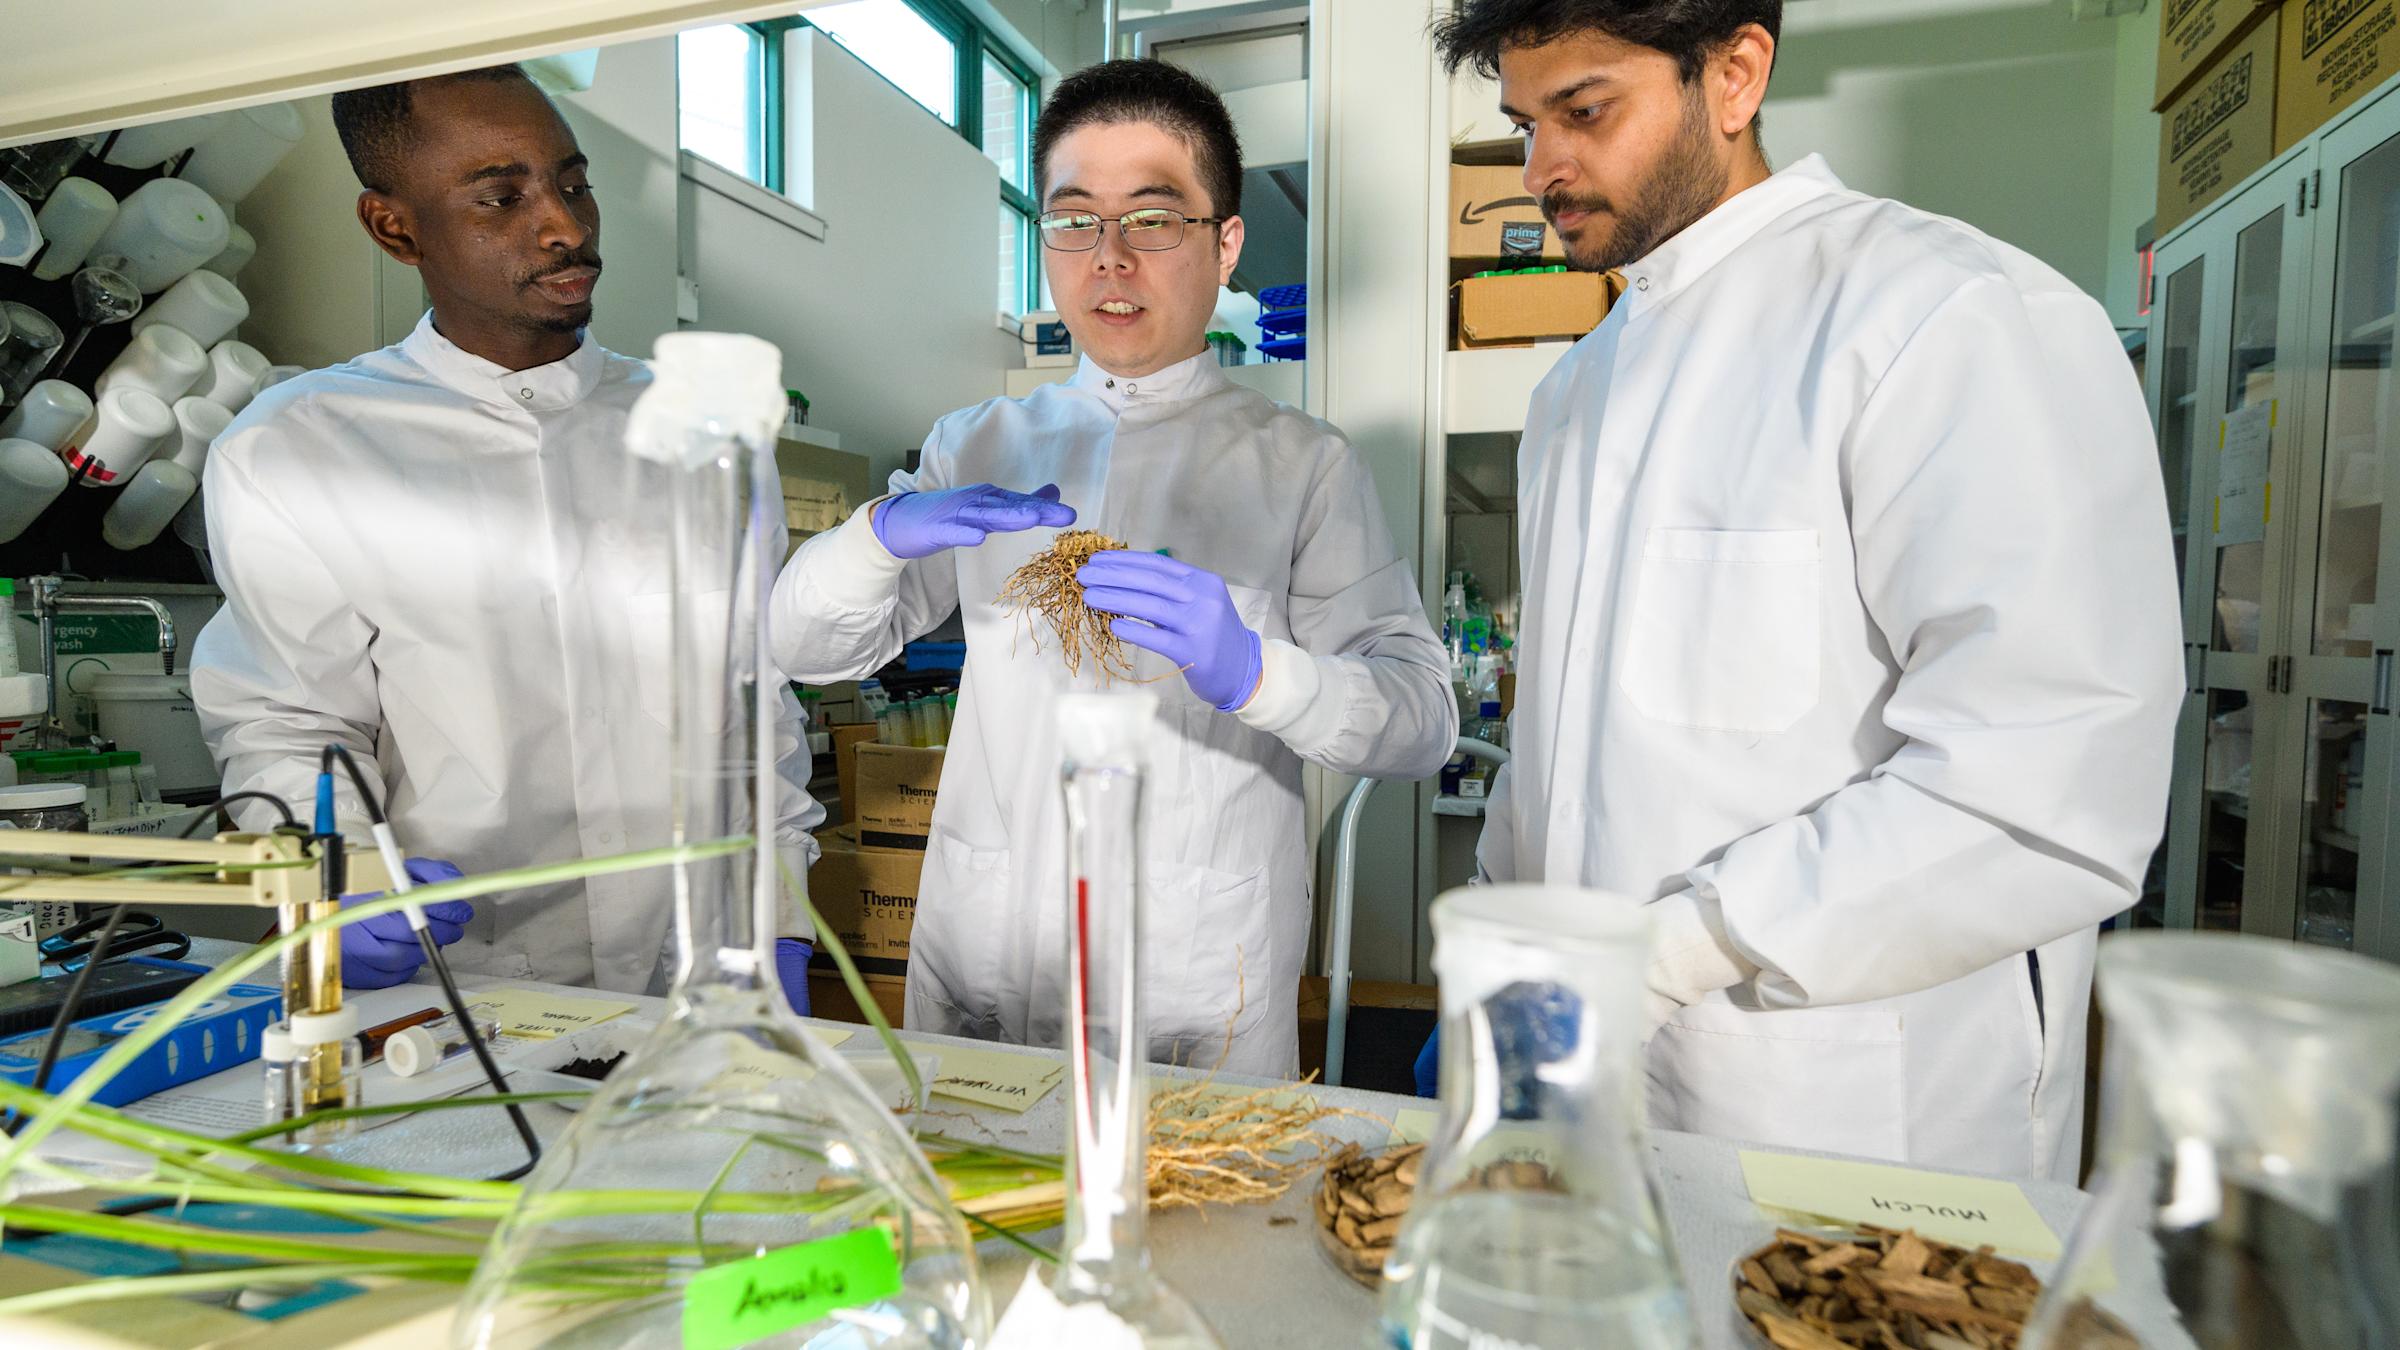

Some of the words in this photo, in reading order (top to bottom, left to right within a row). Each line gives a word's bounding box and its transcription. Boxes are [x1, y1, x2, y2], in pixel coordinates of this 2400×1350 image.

[1506, 227, 1541, 239] prime
[54, 625, 97, 637] rgency
[54, 639, 83, 649] ash
[24, 920, 32, 937] 1
[1871, 1196, 1987, 1221] MULCH
